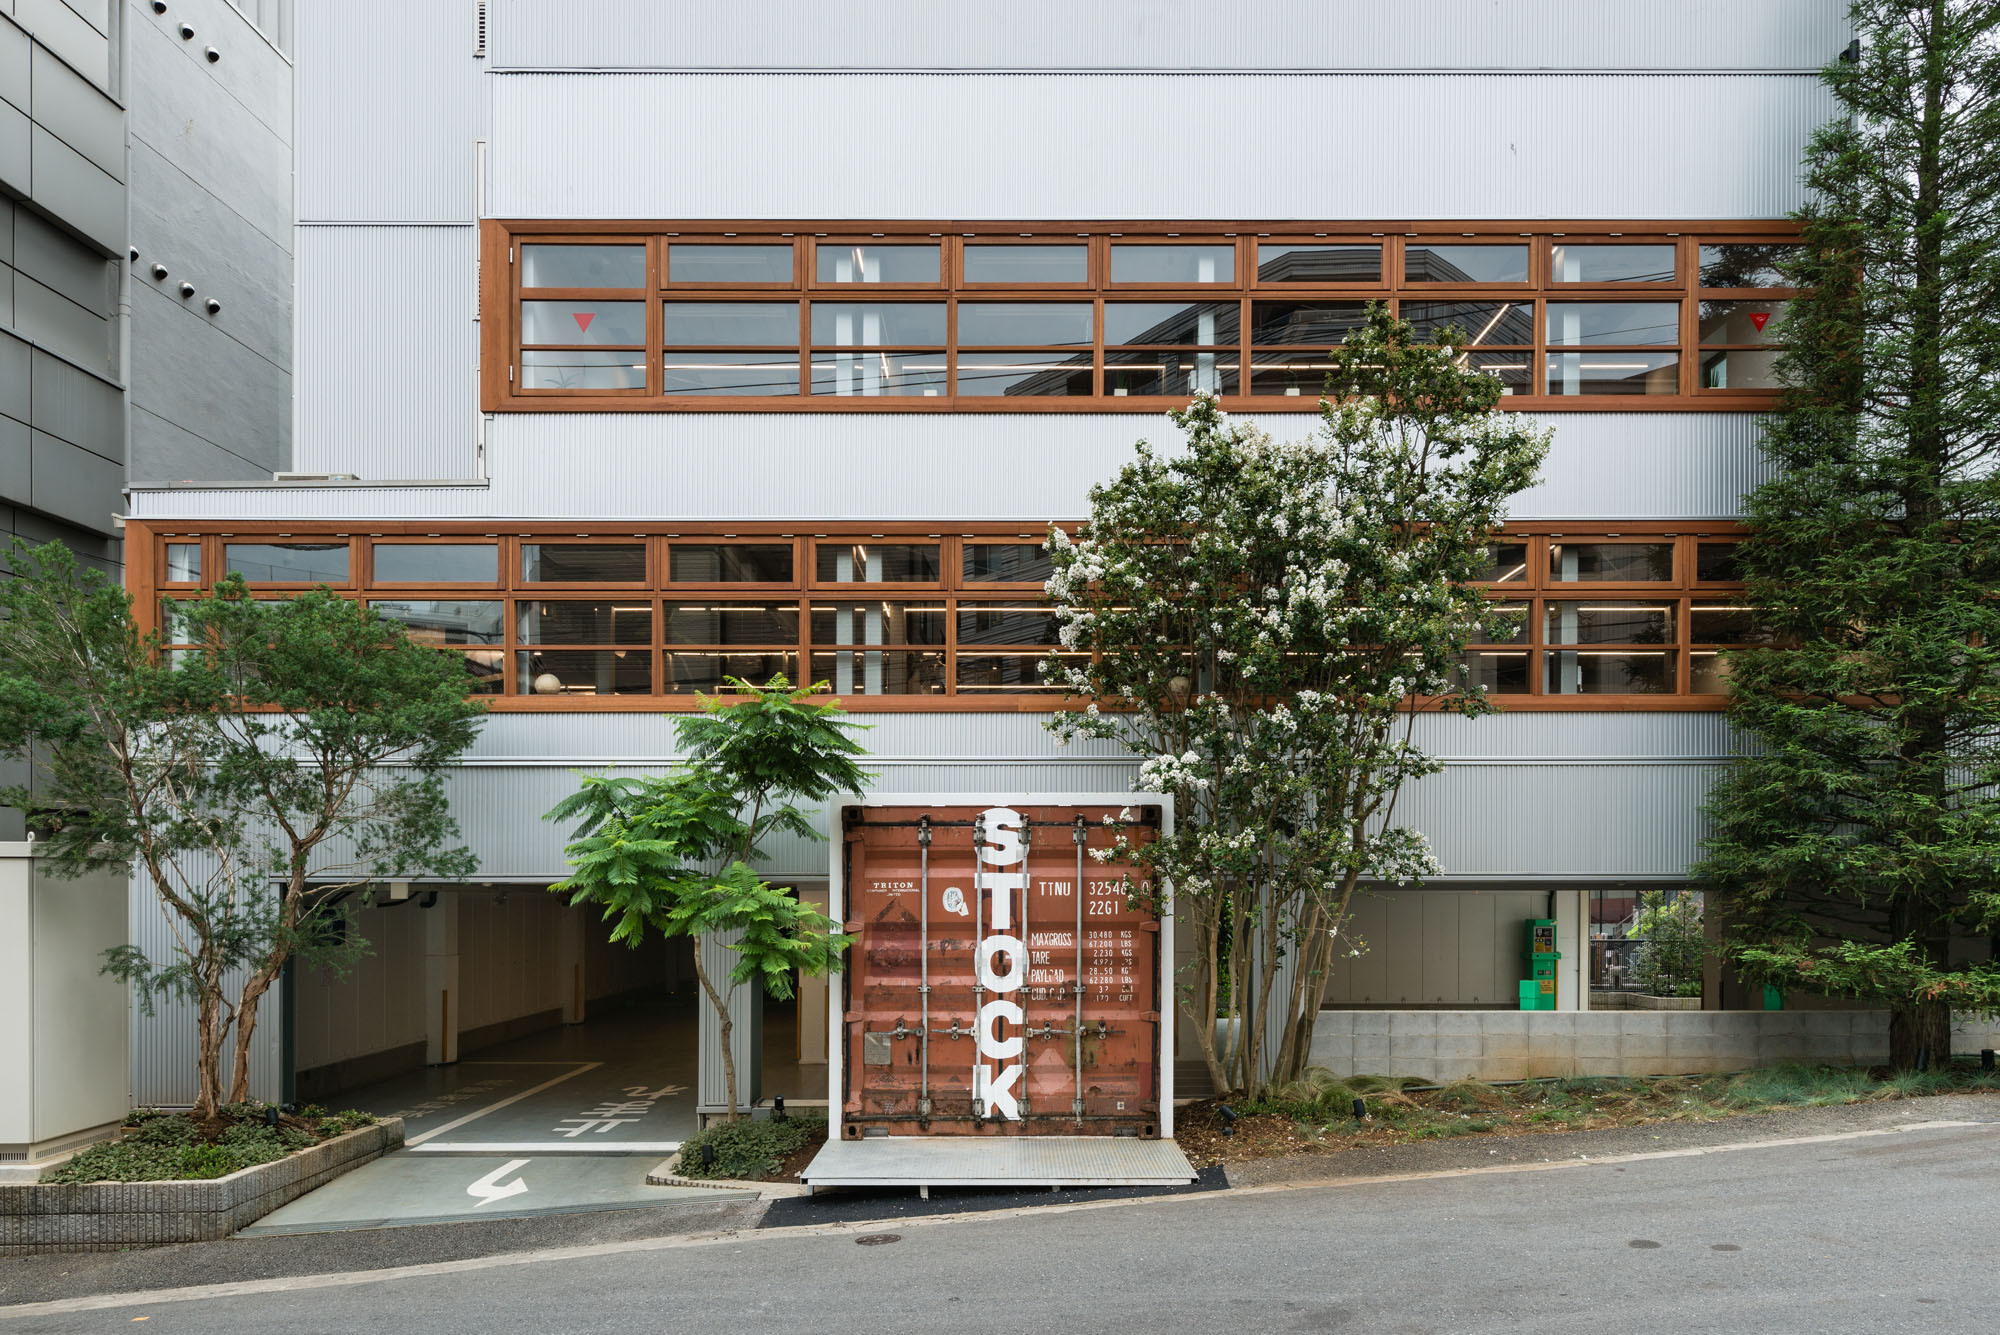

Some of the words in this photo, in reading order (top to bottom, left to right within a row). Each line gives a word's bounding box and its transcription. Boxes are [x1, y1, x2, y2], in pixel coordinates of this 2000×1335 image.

[1039, 881, 1071, 896] TTNU
[1089, 901, 1119, 915] 22G1
[1031, 933, 1072, 946] MAXGROSS
[1089, 940, 1113, 948] 67.200
[973, 807, 1030, 1120] STOCK
[1032, 951, 1051, 965] TARE
[552, 1084, 688, 1137] 止まれ
